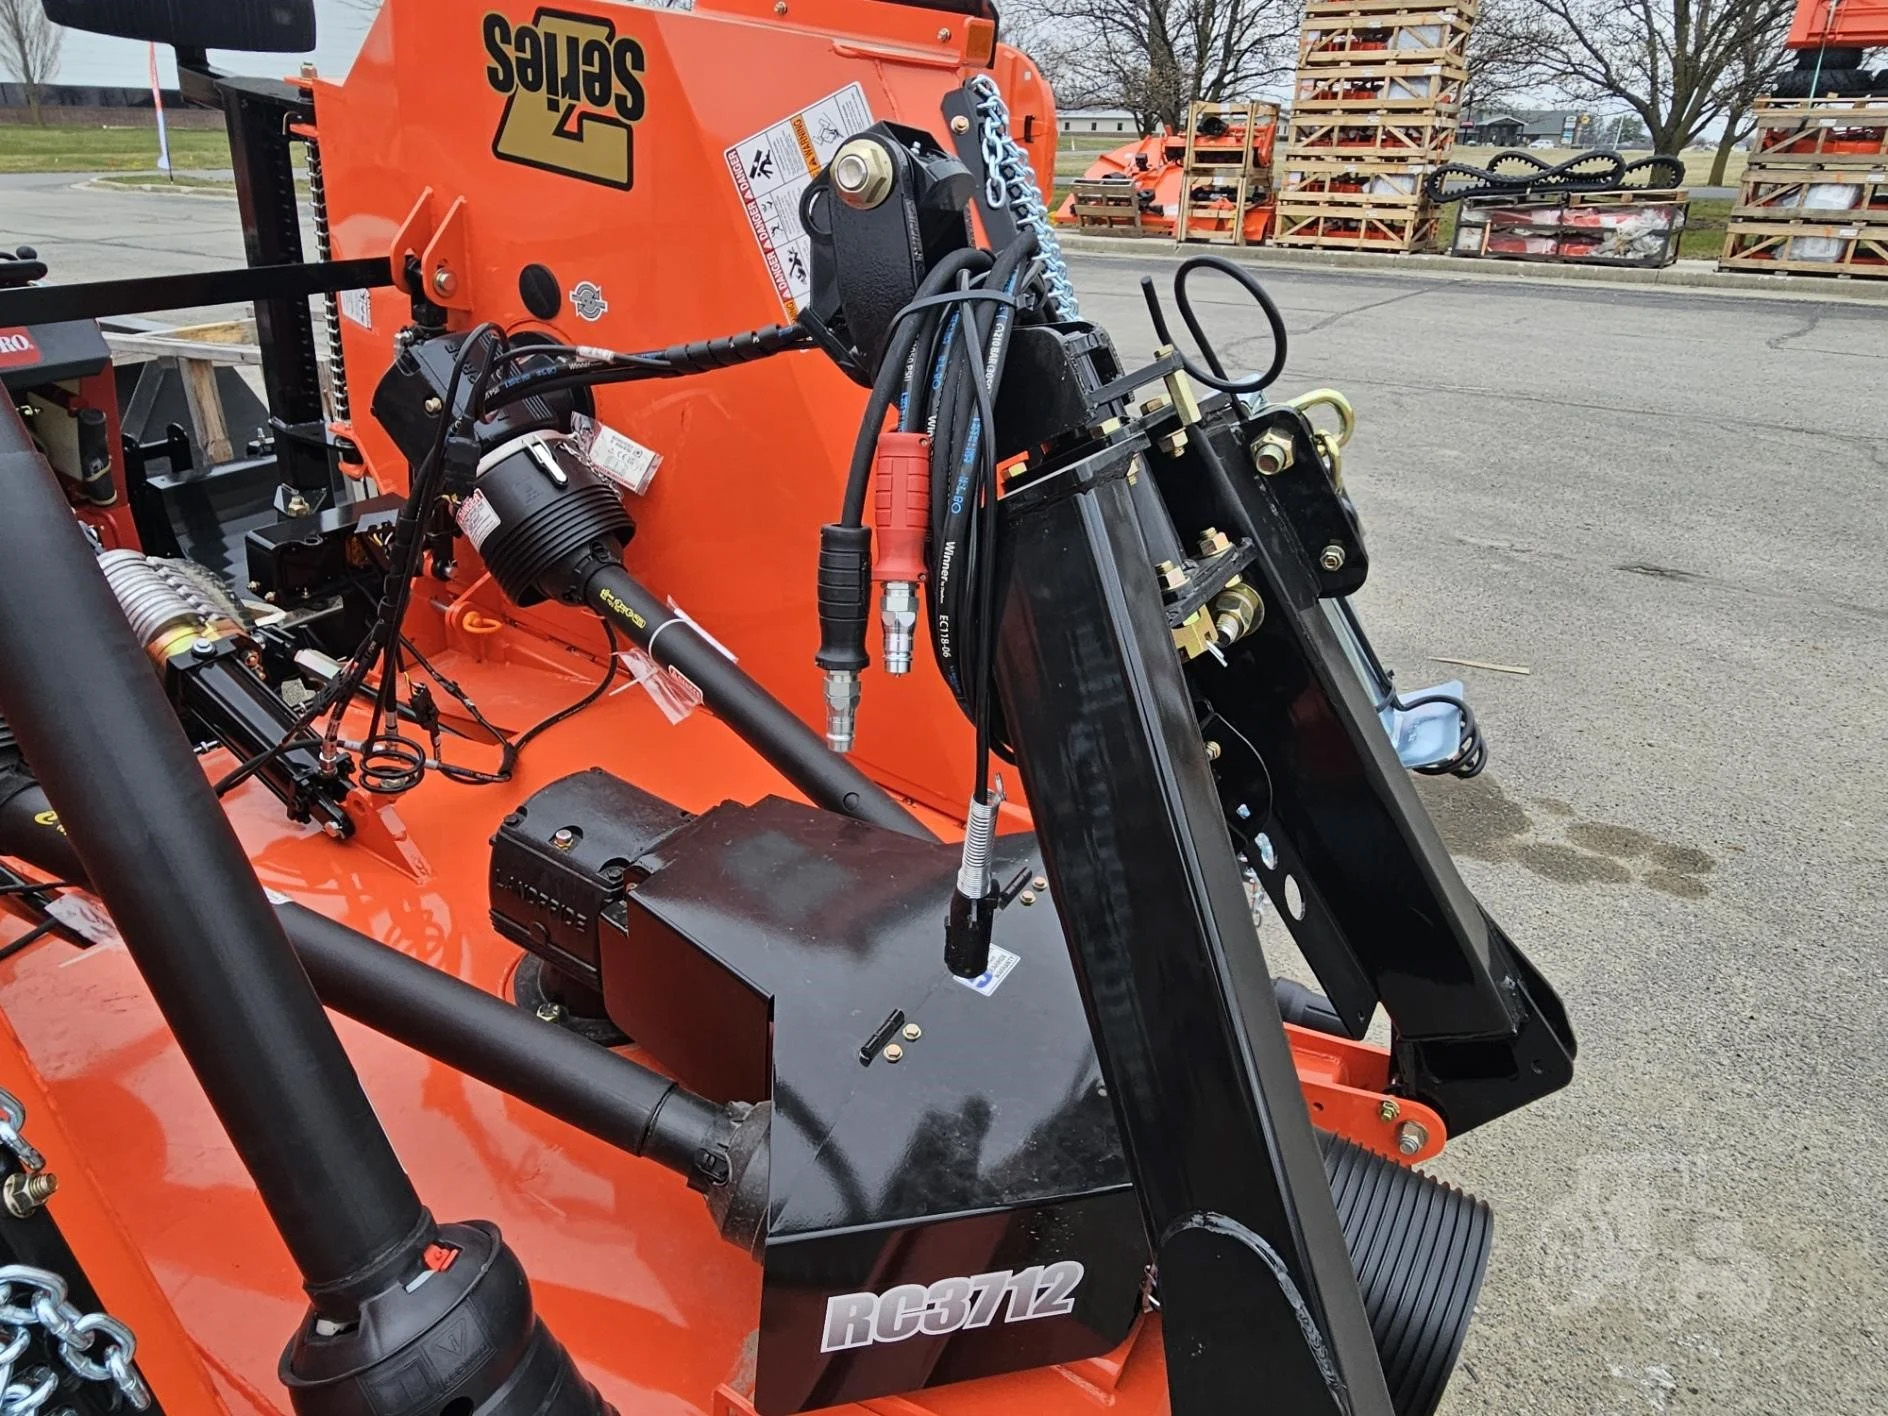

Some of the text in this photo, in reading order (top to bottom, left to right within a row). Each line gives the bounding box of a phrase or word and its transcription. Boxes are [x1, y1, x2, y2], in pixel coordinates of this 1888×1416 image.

[481, 12, 646, 123] Series
[792, 118, 812, 157] WARNING
[727, 149, 749, 195] DANGER
[747, 201, 768, 240] DANGER
[767, 251, 788, 291] DANGER
[988, 346, 1000, 364] BAR
[940, 541, 956, 582] Winner
[939, 614, 952, 658] EC118-06
[820, 1260, 1085, 1353] RC3712
